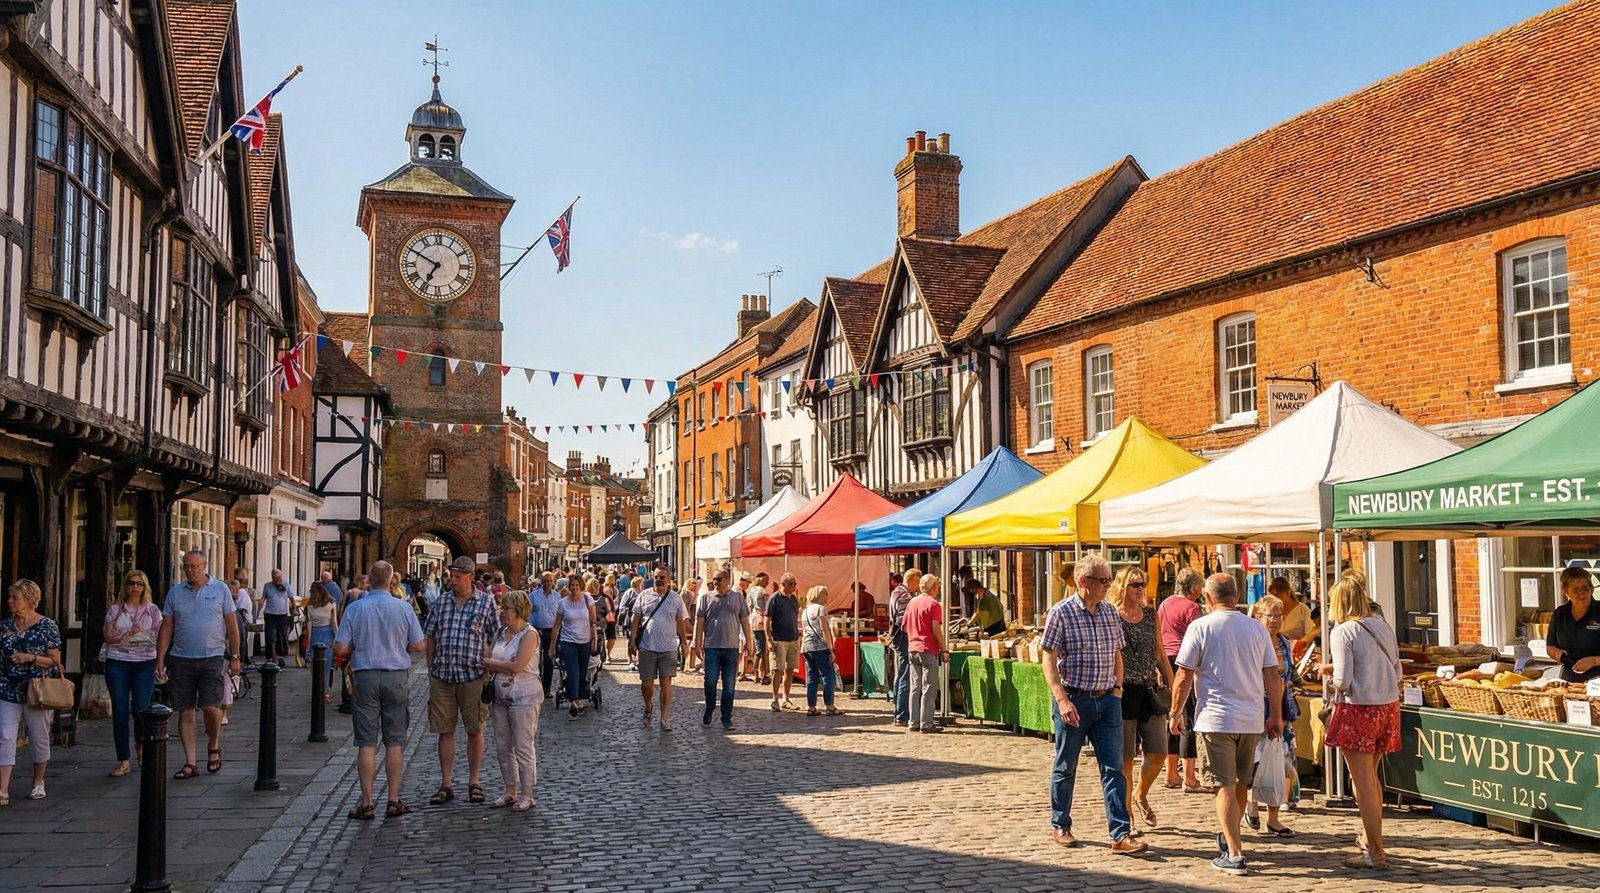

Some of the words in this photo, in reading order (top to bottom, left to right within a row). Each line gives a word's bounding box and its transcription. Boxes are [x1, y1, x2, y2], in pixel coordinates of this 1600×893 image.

[1272, 392, 1309, 401] NEWBURY
[1348, 489, 1434, 515] NEWBURY
[1440, 482, 1524, 510] MARKET
[1543, 478, 1590, 503] EST.
[1414, 727, 1584, 785] NEWBURY
[1471, 778, 1505, 802] EST.
[1512, 786, 1548, 811] 1215
